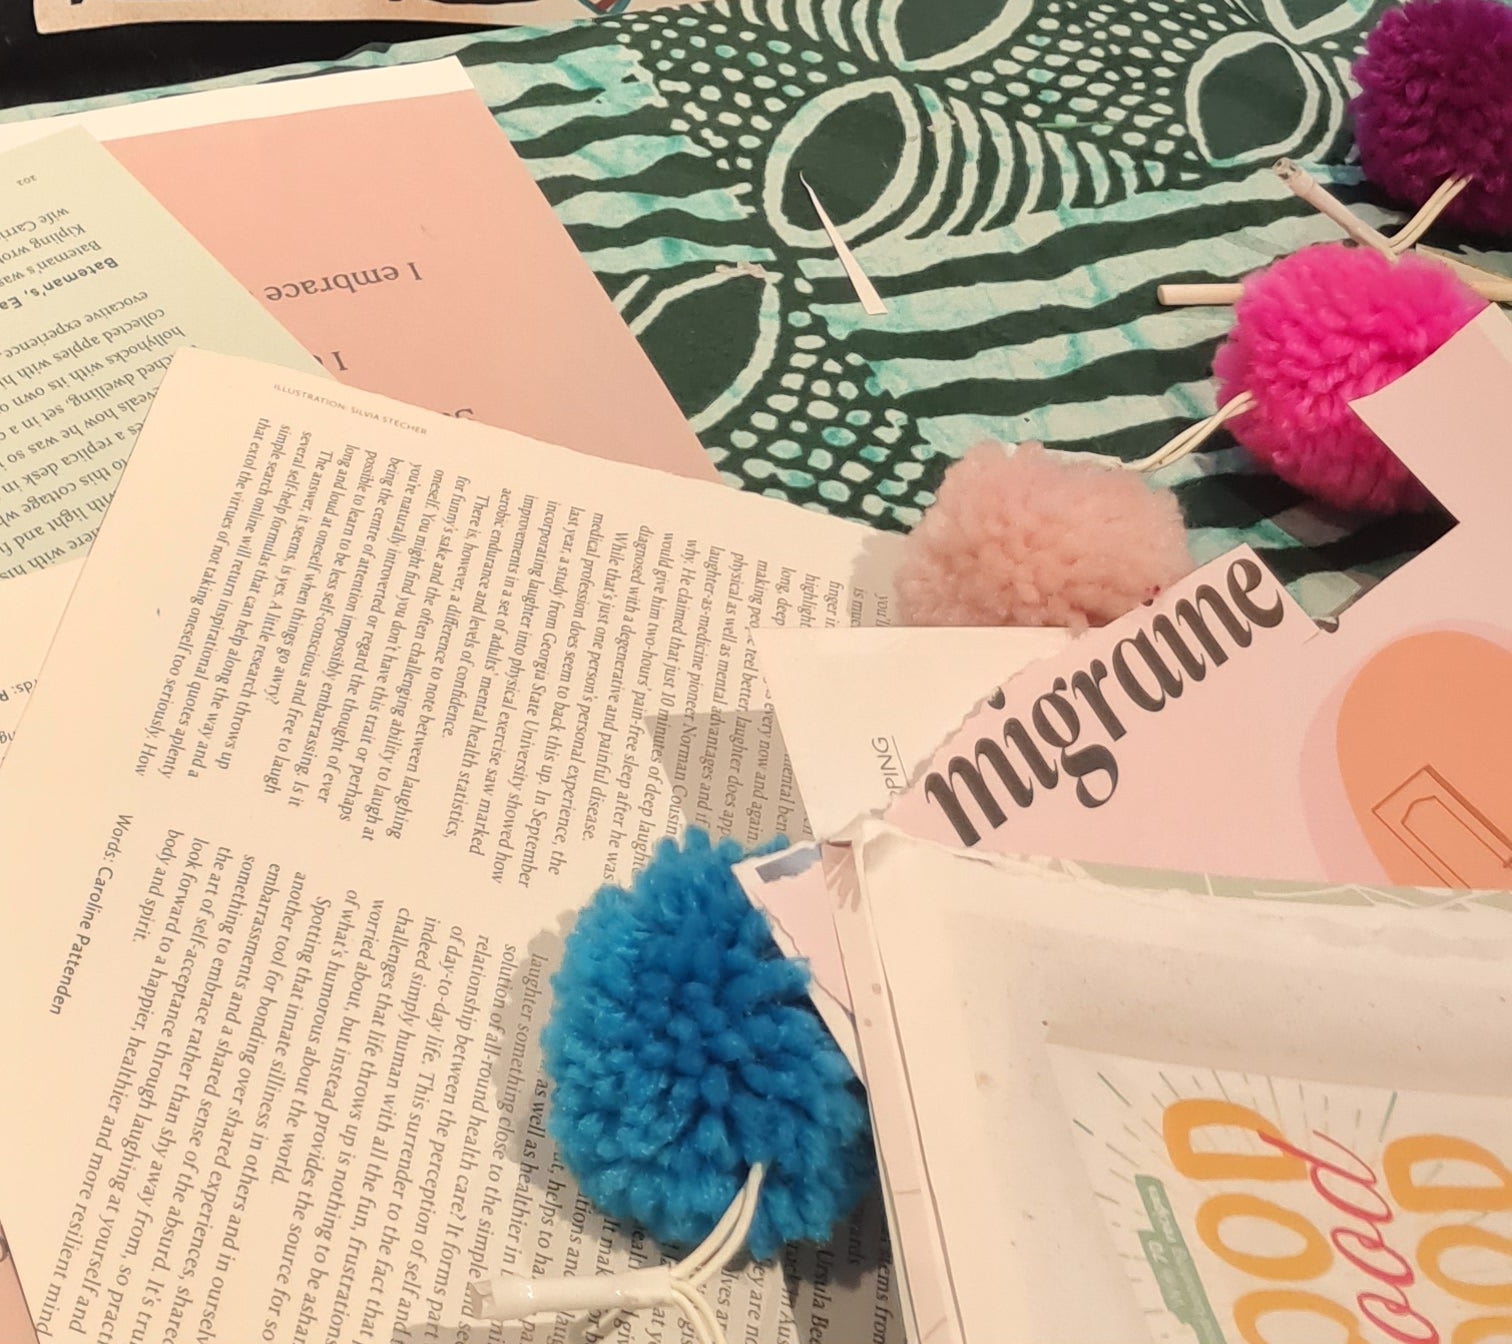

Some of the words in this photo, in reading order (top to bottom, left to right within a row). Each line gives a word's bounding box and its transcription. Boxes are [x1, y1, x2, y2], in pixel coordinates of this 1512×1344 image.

[37, 207, 70, 226] wife
[28, 223, 87, 249] Kipling
[25, 239, 103, 275] Bateman's
[406, 261, 424, 281] I
[23, 256, 120, 297] Bateman's,
[263, 265, 400, 302] embrace
[83, 291, 149, 324] evocative
[101, 308, 166, 344] collected
[52, 335, 102, 363] apples
[330, 350, 349, 372] I
[16, 358, 53, 380] with
[349, 405, 380, 421] SILVIA
[381, 415, 428, 436] STECHER
[314, 450, 334, 472] The
[299, 471, 323, 512] answer,
[296, 513, 313, 524] it
[282, 524, 306, 562] seems,
[271, 575, 289, 598] yes.
[280, 564, 297, 576] is
[267, 599, 284, 610] A
[258, 611, 282, 643] little
[239, 643, 267, 699] research
[924, 558, 1285, 848] migraine
[224, 700, 252, 750] throws
[213, 751, 233, 770] up
[871, 736, 905, 798] PING
[102, 814, 134, 863] Words:
[155, 828, 186, 866] body
[79, 866, 114, 930] Caroline
[147, 866, 167, 898] and
[131, 897, 157, 943] spirit.
[48, 932, 92, 1016] Pattenden
